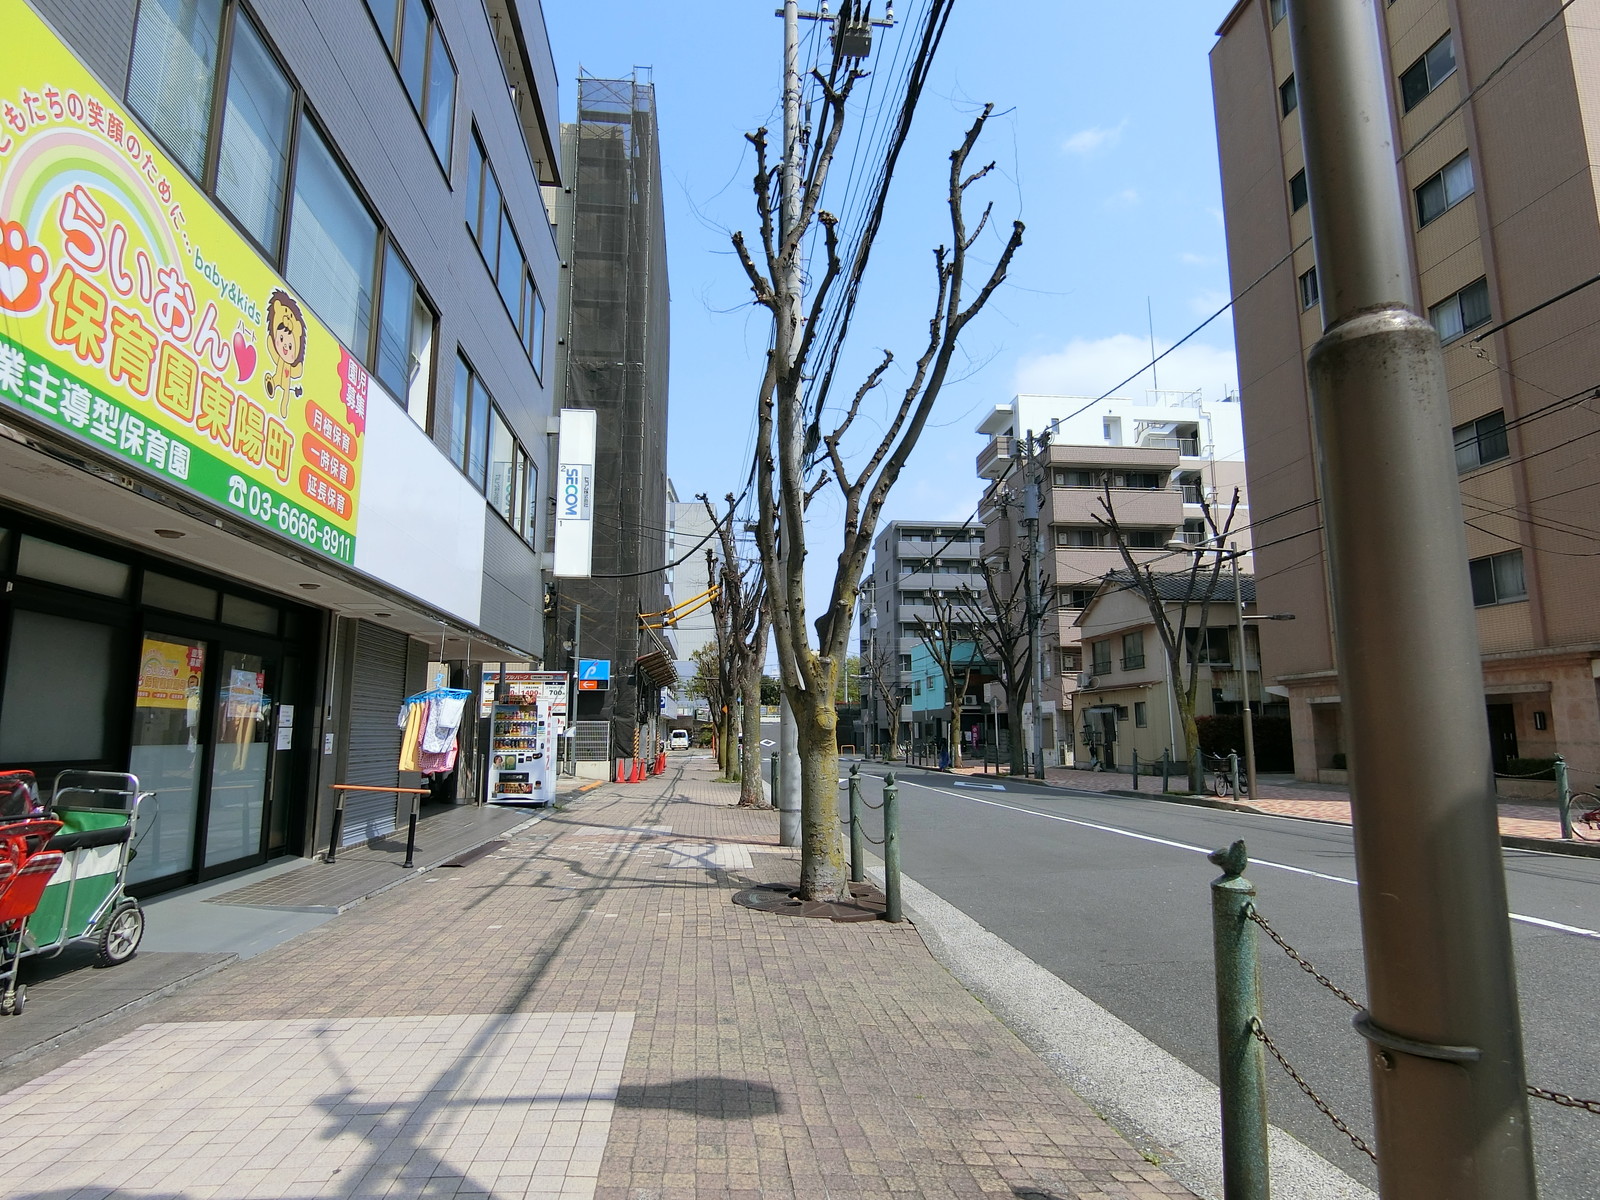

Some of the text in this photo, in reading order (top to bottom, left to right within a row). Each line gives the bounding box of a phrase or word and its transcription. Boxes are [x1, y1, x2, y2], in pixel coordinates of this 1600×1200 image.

[60, 185, 230, 372] らいおん
[195, 248, 261, 325] baby&kids
[238, 320, 257, 342] ハート
[50, 263, 294, 482] 保育園東陽町
[347, 358, 367, 396] 園児
[346, 383, 365, 420] 募集
[313, 409, 351, 454] 月極保育
[310, 447, 349, 484] 一時保育
[306, 473, 346, 515] 延長保育
[565, 468, 578, 516] SECOM
[249, 486, 351, 561] 03-6666-8911
